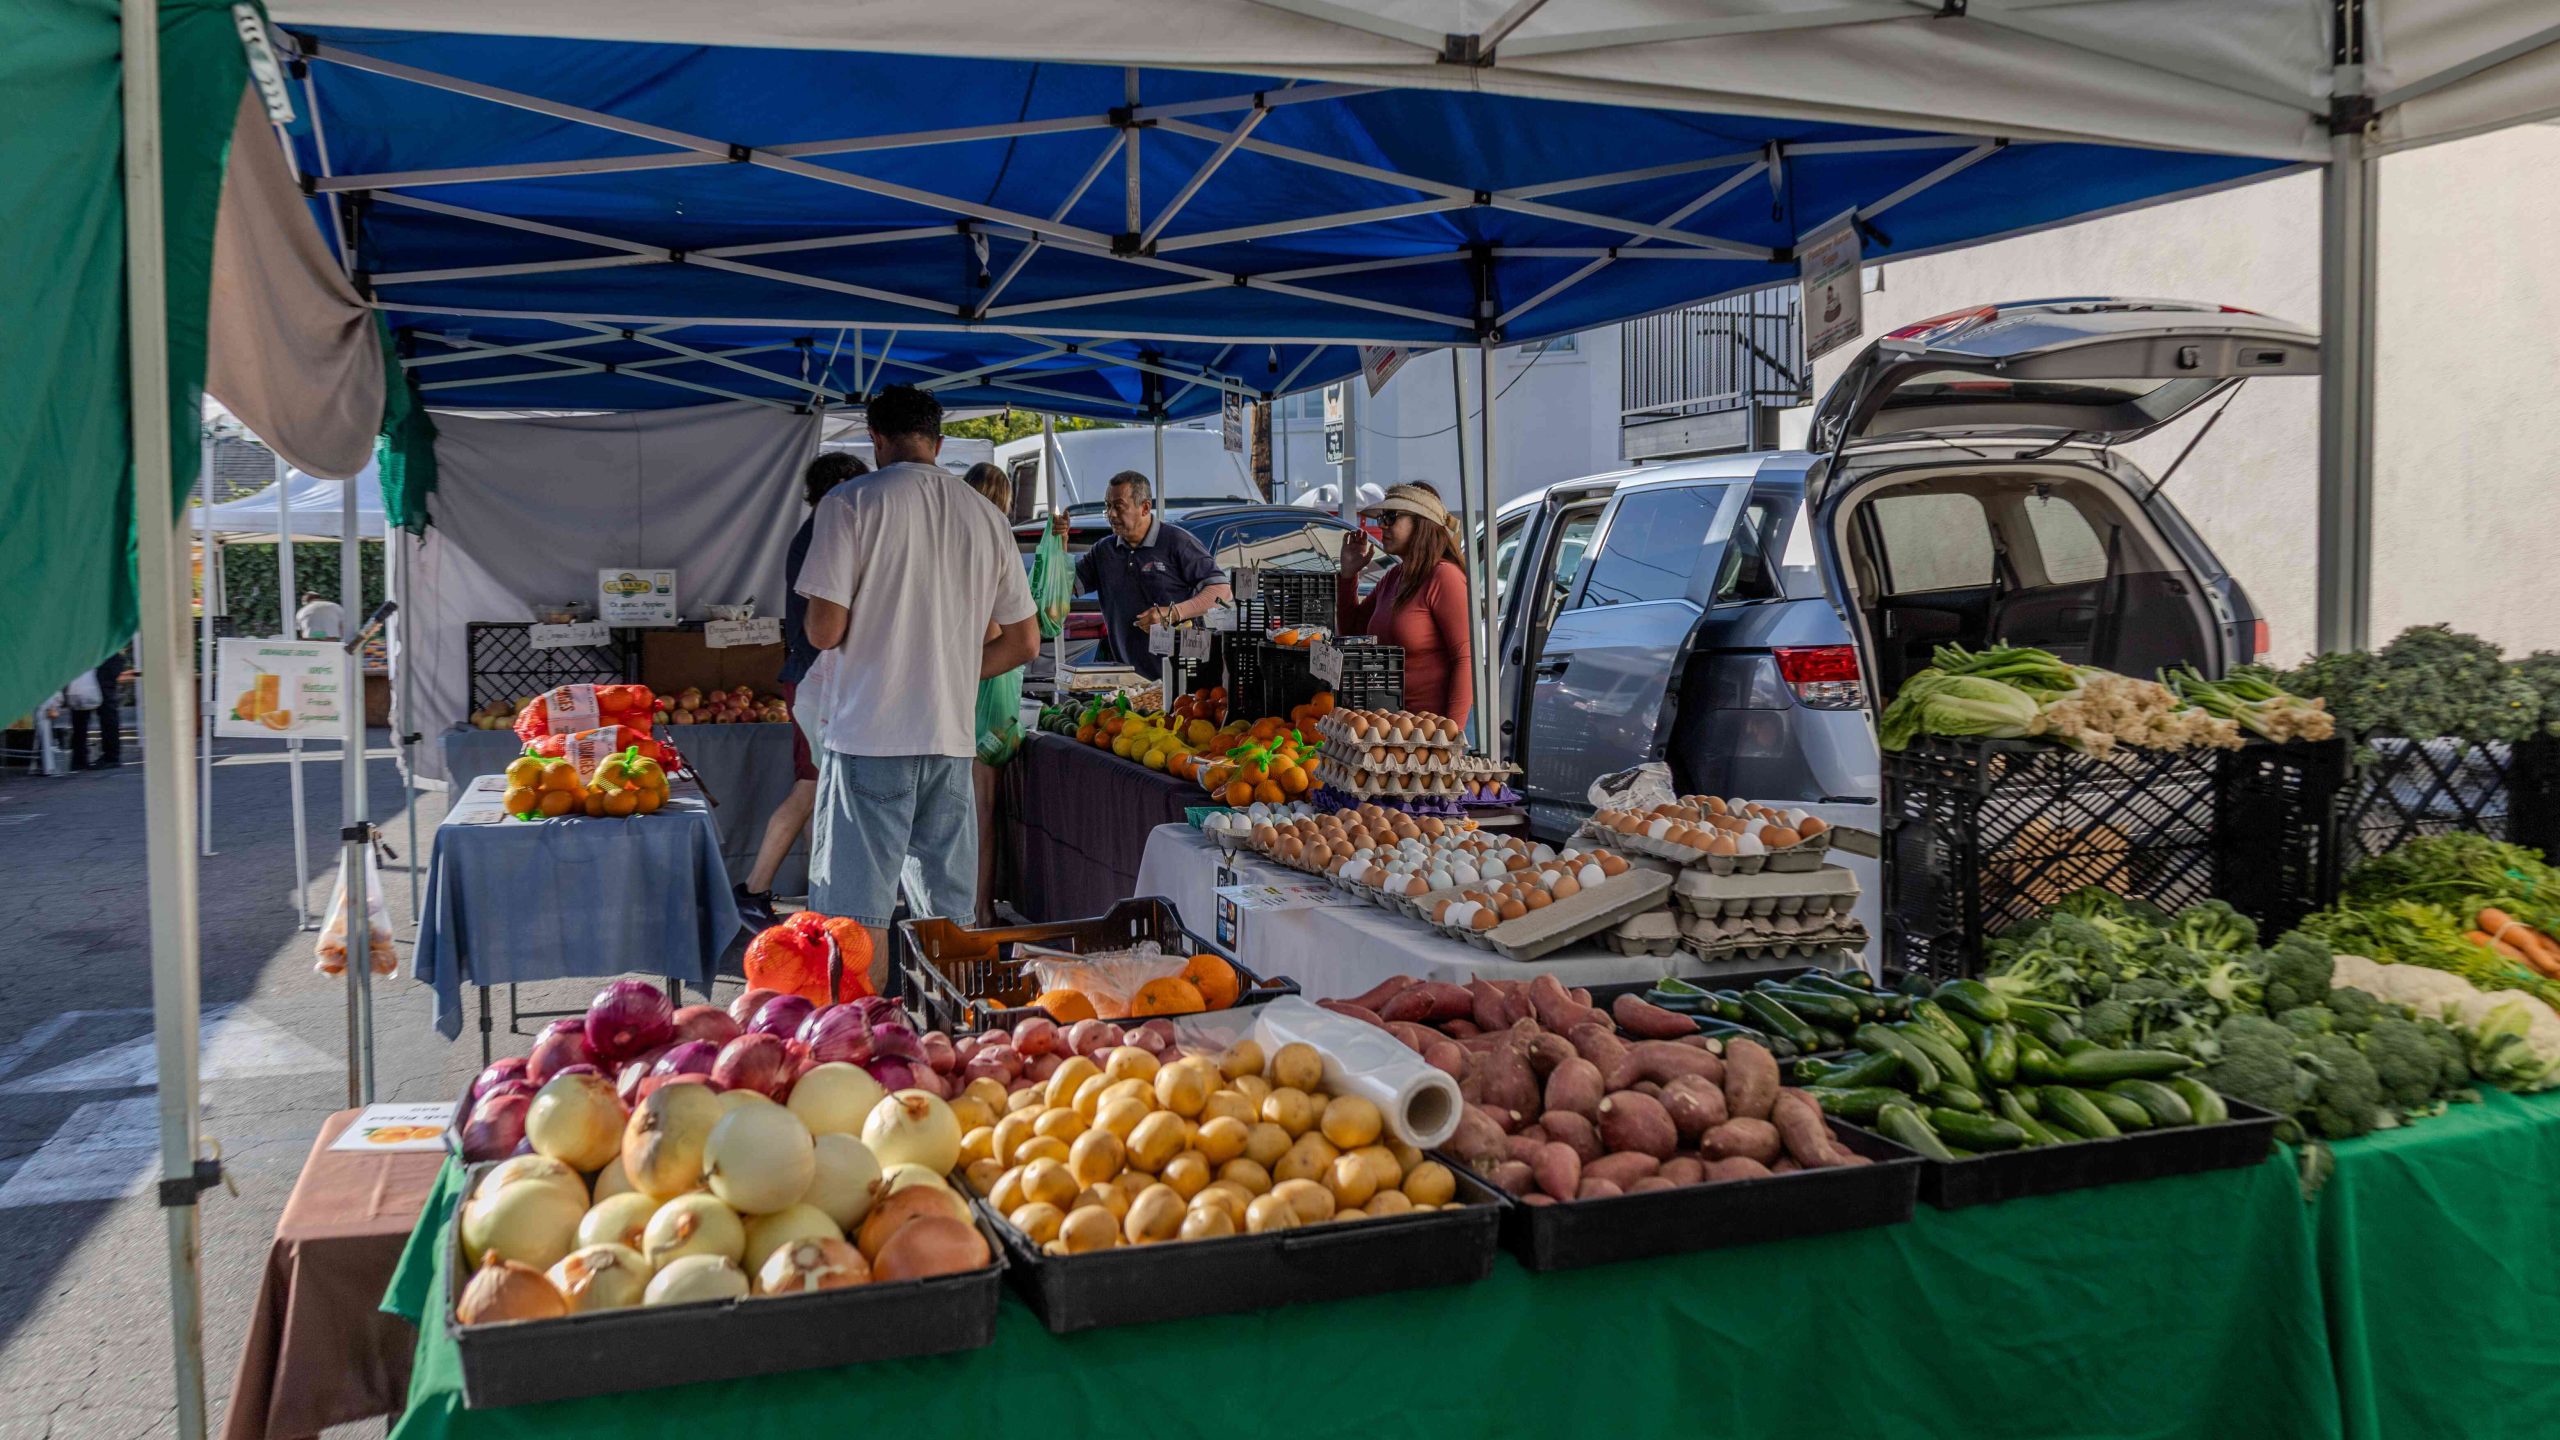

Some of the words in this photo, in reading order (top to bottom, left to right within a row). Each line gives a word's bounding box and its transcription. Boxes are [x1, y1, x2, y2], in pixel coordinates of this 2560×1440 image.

[641, 600, 666, 610] Apples
[309, 666, 333, 674] 100%
[579, 741, 596, 776] ORANGES
